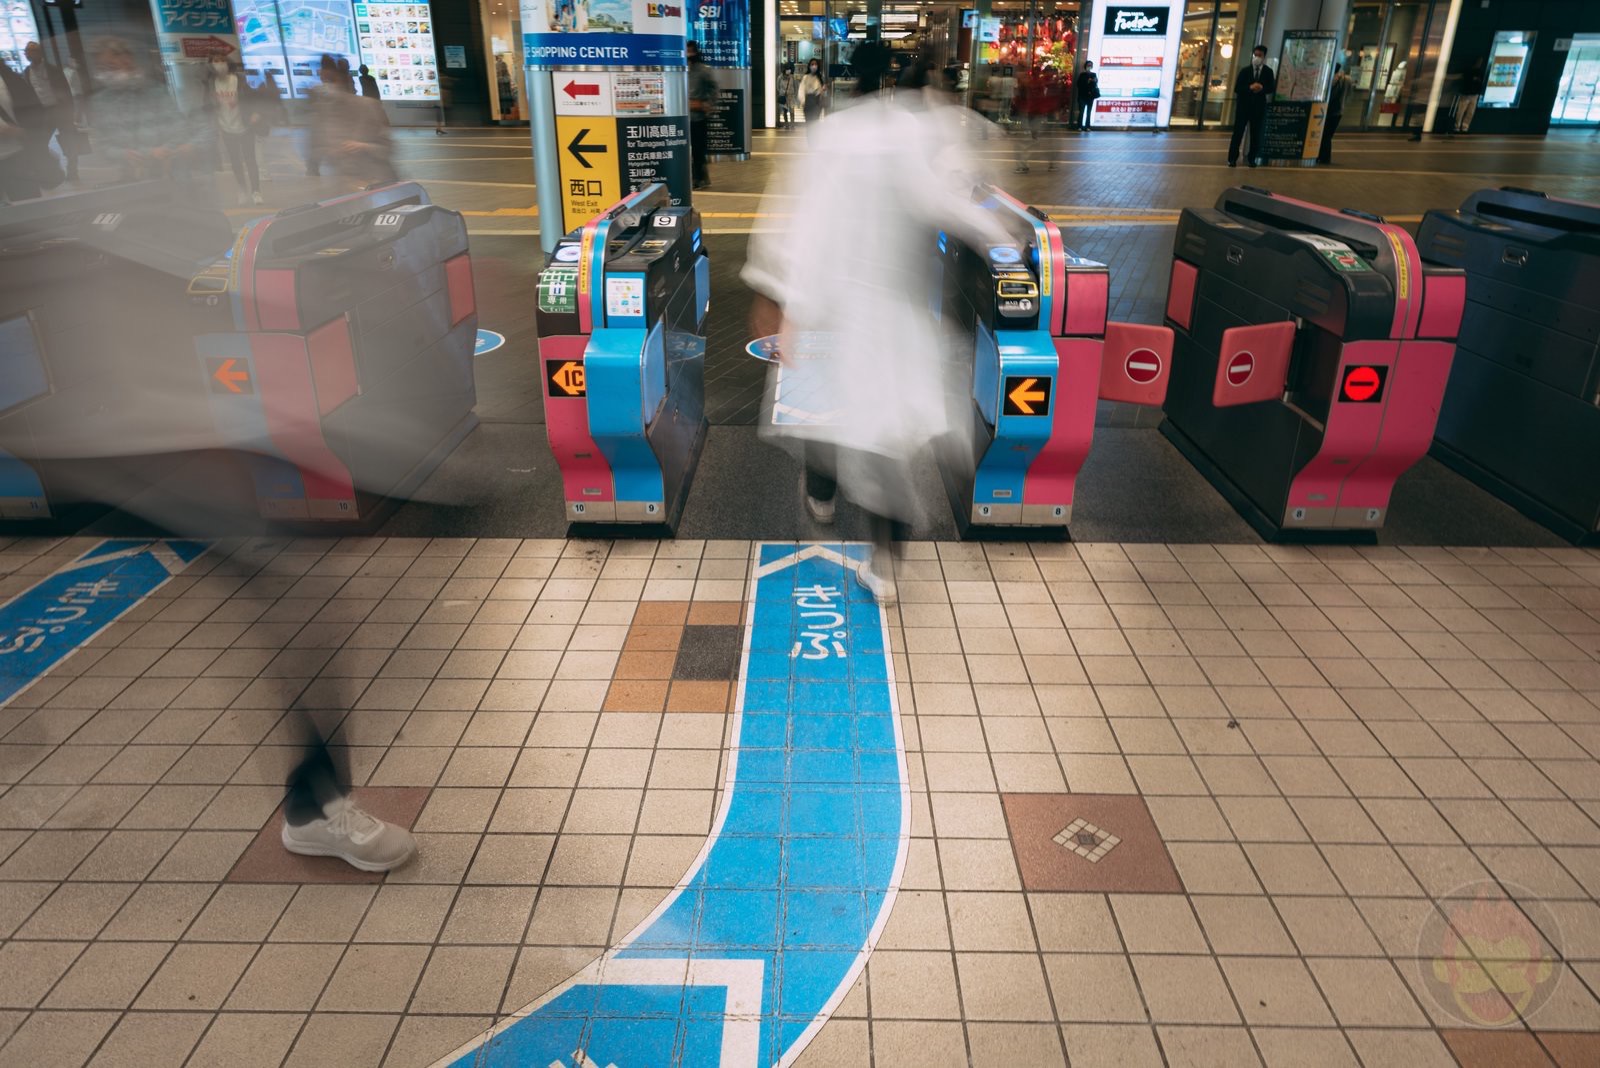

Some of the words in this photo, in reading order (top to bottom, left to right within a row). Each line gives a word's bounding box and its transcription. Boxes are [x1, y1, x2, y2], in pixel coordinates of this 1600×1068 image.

[698, 5, 721, 18] SBI
[531, 46, 576, 58] SHOPPING
[579, 46, 629, 59] CENTER
[626, 124, 677, 139] 玉川高島屋
[628, 168, 656, 177] 玉川通り
[570, 179, 602, 196] 西口
[379, 215, 398, 225] 10
[659, 216, 671, 226] 9
[564, 369, 584, 387] IC
[339, 502, 348, 511] 10
[575, 504, 584, 512] 10
[648, 504, 655, 512] 9
[983, 507, 989, 515] 9
[1055, 507, 1061, 515] 8
[1296, 510, 1302, 518] 8
[1369, 510, 1376, 519] 7
[788, 584, 848, 660] きっぷ
